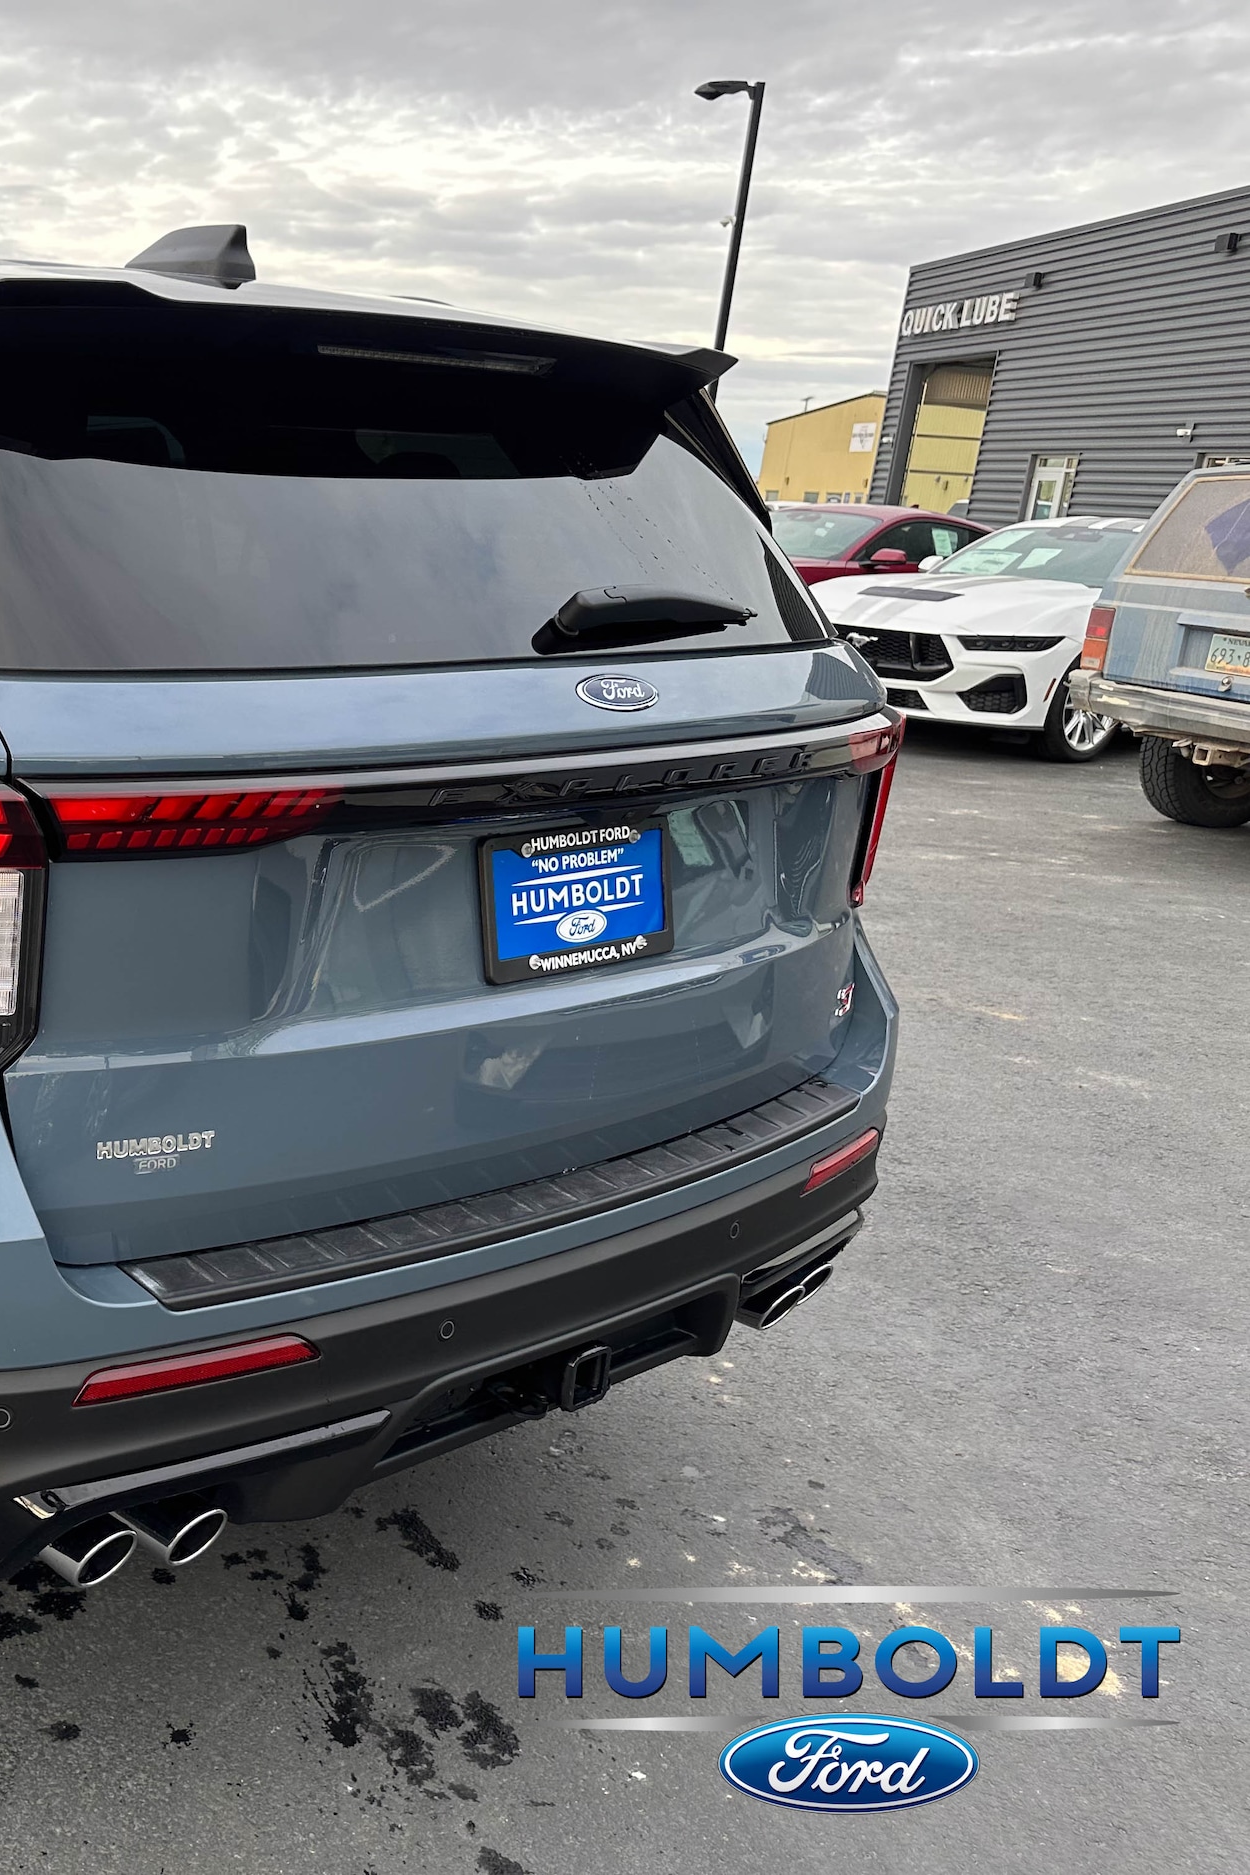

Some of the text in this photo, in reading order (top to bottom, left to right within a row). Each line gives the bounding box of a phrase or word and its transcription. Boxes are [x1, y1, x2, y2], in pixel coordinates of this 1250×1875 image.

[901, 292, 1019, 336] QUICK LUBE
[600, 679, 646, 700] Ford
[429, 751, 816, 807] EXPLORER
[530, 825, 631, 851] HUMBOLDT FORD
[511, 874, 644, 917] HUMBOLDT
[568, 916, 597, 937] Ford
[539, 941, 638, 972] WINNEMUCCA, NV
[96, 1130, 216, 1160] HUMBOLDT
[138, 1157, 177, 1171] FORD
